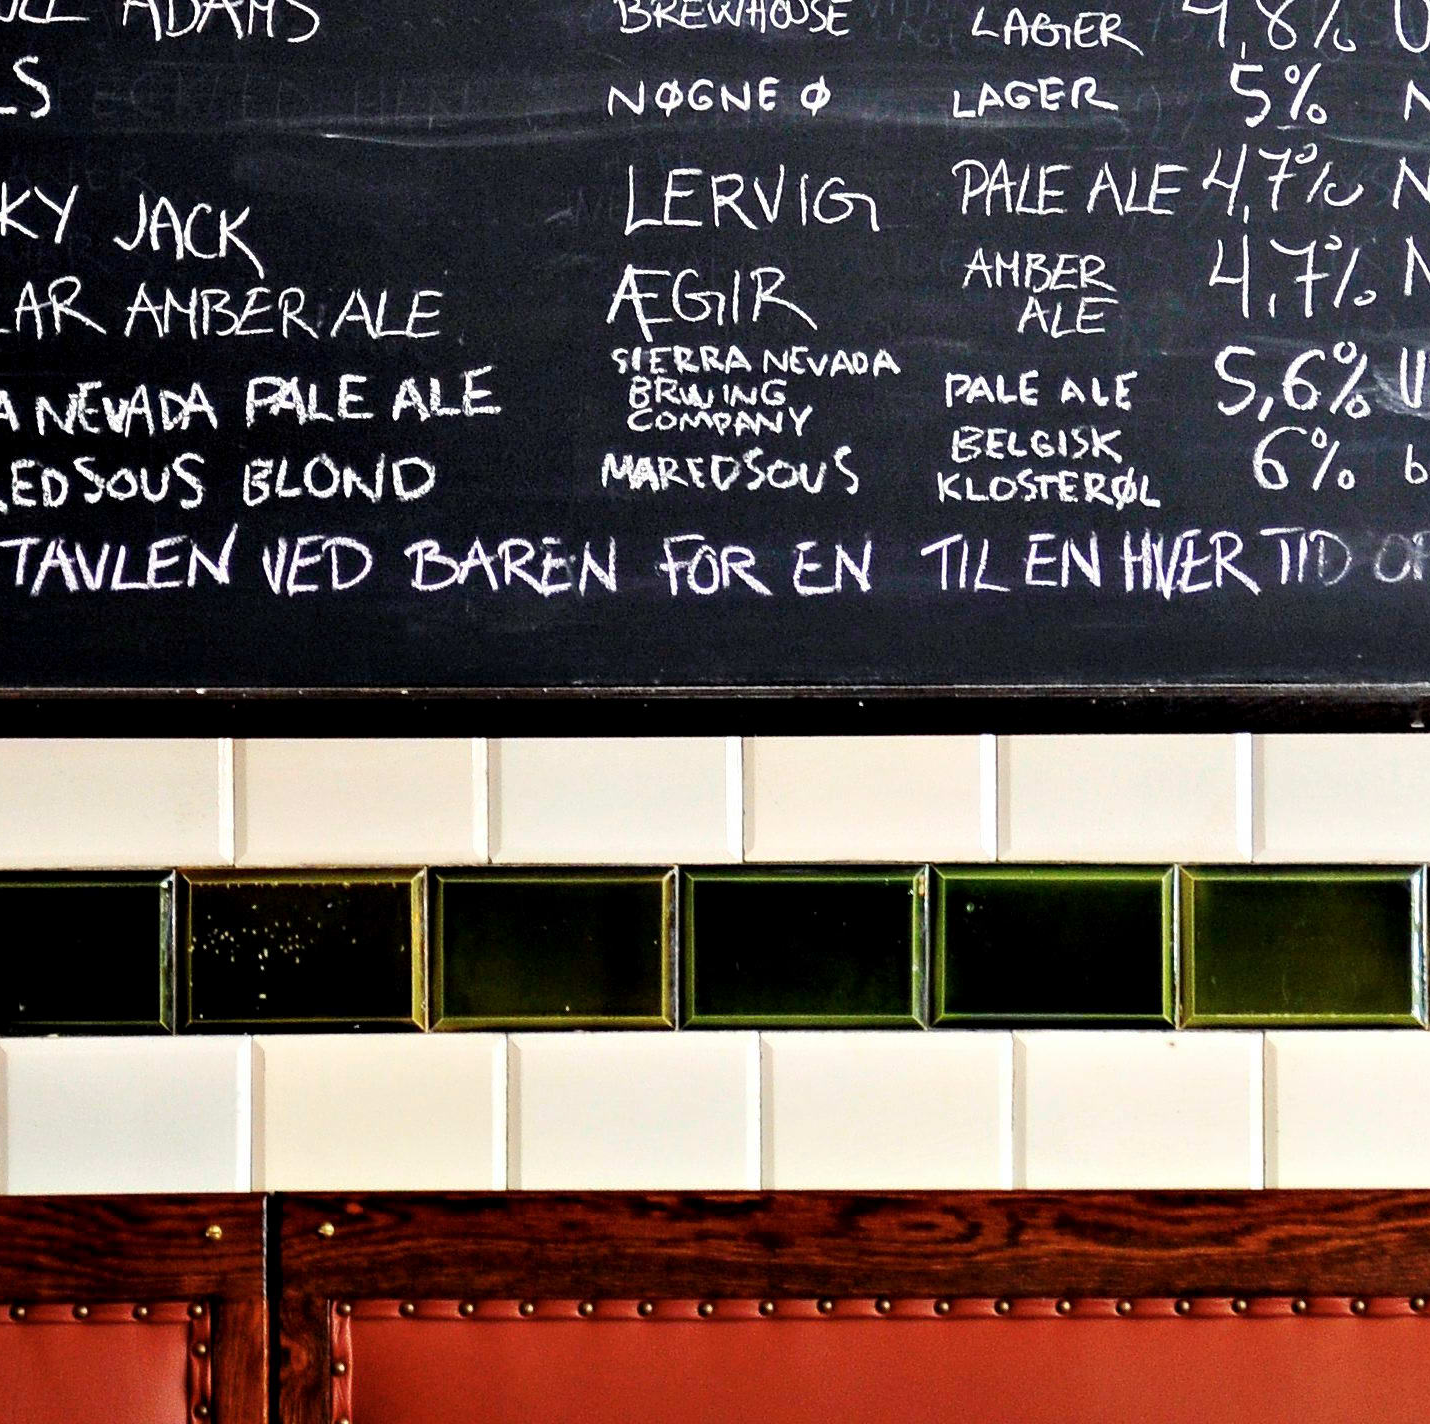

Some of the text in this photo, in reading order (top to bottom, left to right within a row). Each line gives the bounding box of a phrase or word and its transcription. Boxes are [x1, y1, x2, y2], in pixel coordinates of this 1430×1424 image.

[972, 7, 1144, 56] LAGER
[608, 77, 779, 117] NØGNE
[953, 77, 1119, 118] LAGER
[1230, 63, 1327, 130] 5%
[624, 164, 880, 236] LERVIG
[952, 159, 1188, 216] PALE ALE
[1202, 143, 1364, 224] 4,7%
[113, 192, 264, 279] JACK
[962, 248, 1116, 293] AMBER
[1209, 234, 1376, 318] 4,7%
[125, 289, 318, 339] AMBER
[330, 288, 443, 339] ALE
[606, 264, 817, 342] ÆGIR
[1017, 296, 1118, 338] ALE
[611, 345, 901, 377] SIERRA NEVADA
[1215, 341, 1371, 421] 5,6%
[35, 381, 218, 437] NEVADA
[246, 374, 374, 428] PALE
[392, 366, 501, 422] ALE
[945, 370, 1137, 410] PALE ALE
[627, 405, 813, 437] COMPANY
[951, 426, 1122, 463] BELGISK
[243, 453, 436, 507] BLOND
[602, 446, 859, 494] MAREDSOUS
[1253, 426, 1355, 491] 6%
[937, 467, 1161, 511] KLOSTERØL
[262, 535, 372, 597] VED
[404, 536, 617, 597] BAREN
[659, 534, 773, 596] FOR
[793, 540, 872, 596] EN
[921, 534, 1010, 592] TIL
[1024, 531, 1101, 588] EN
[1120, 529, 1261, 600] HVER
[1260, 527, 1352, 585] TID
